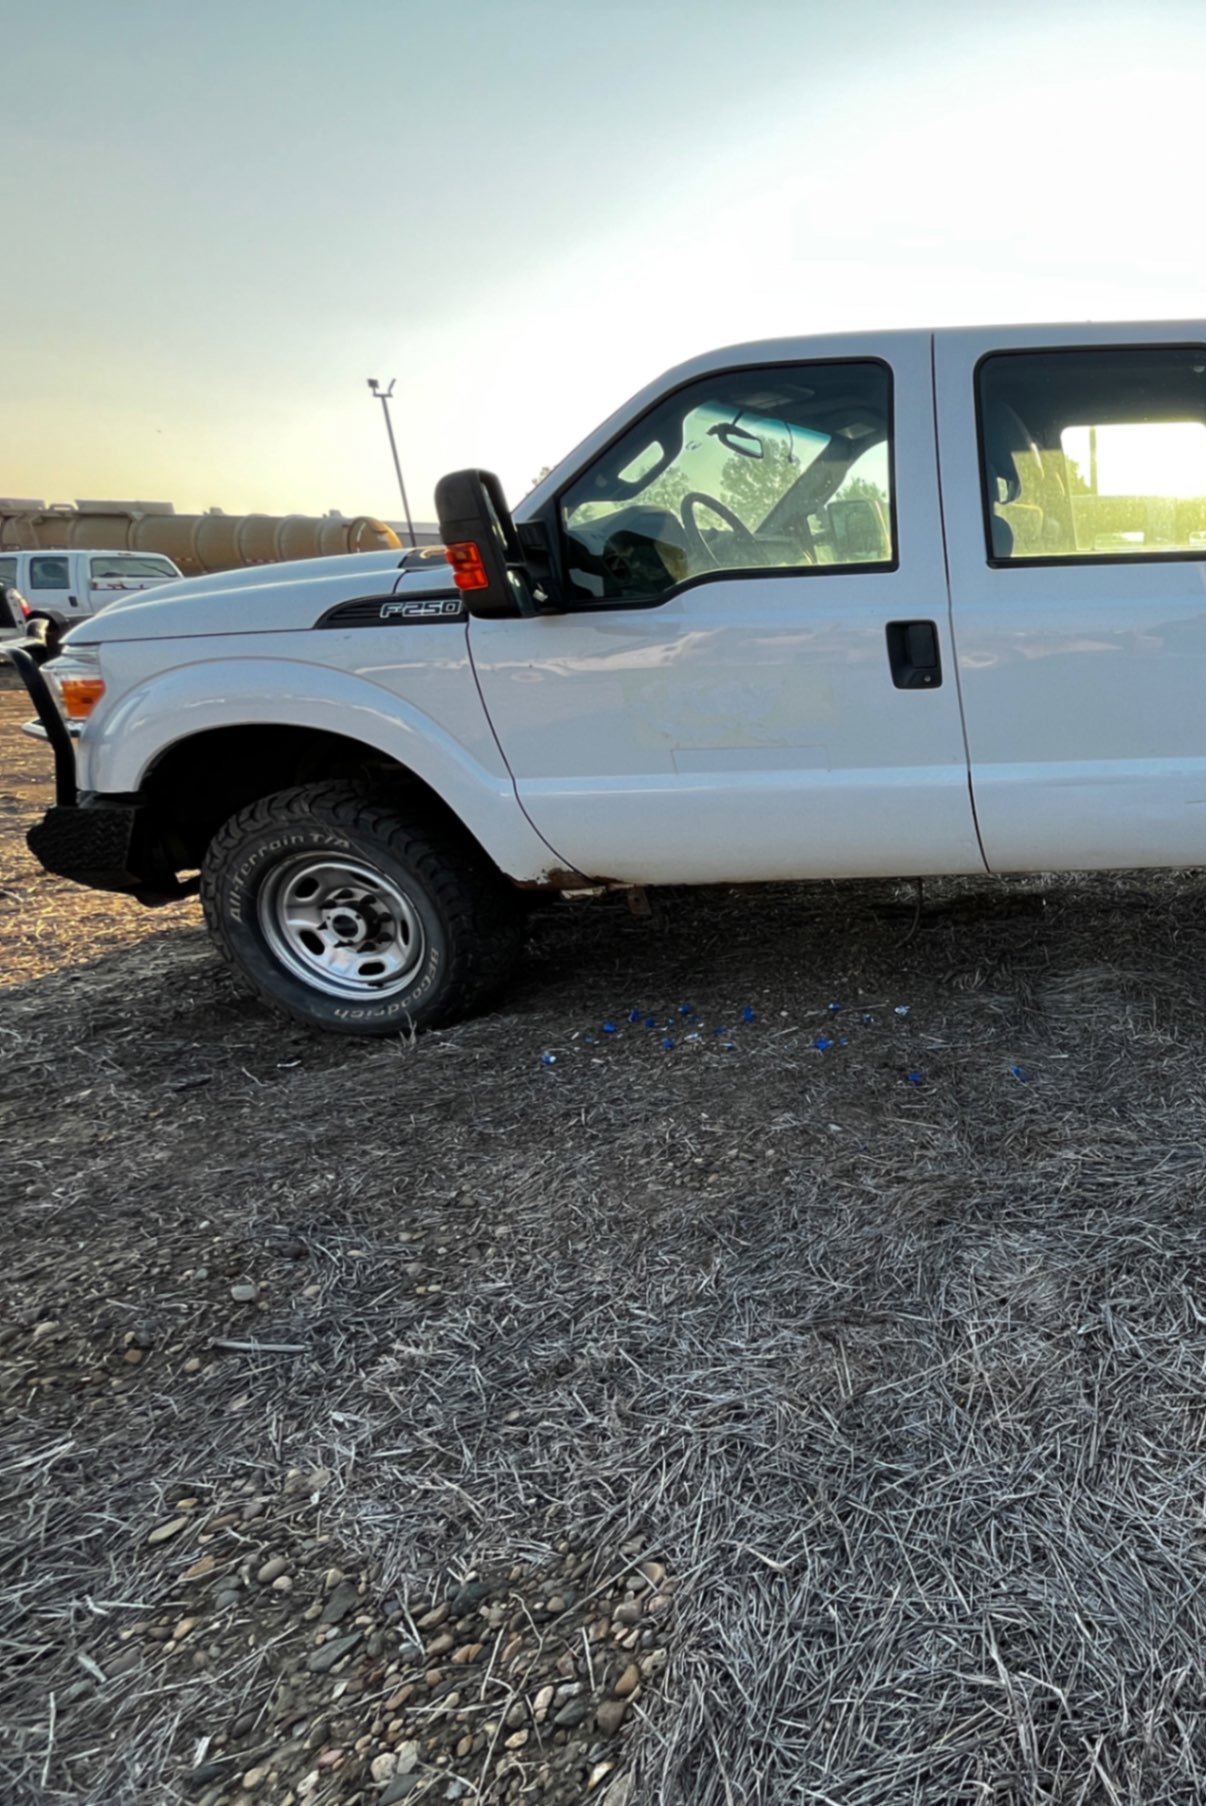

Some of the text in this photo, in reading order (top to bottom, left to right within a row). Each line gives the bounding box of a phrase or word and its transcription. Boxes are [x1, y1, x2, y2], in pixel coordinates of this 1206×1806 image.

[229, 833, 349, 923] All-Terrain T/A
[334, 946, 439, 1019] BFGoodrich
